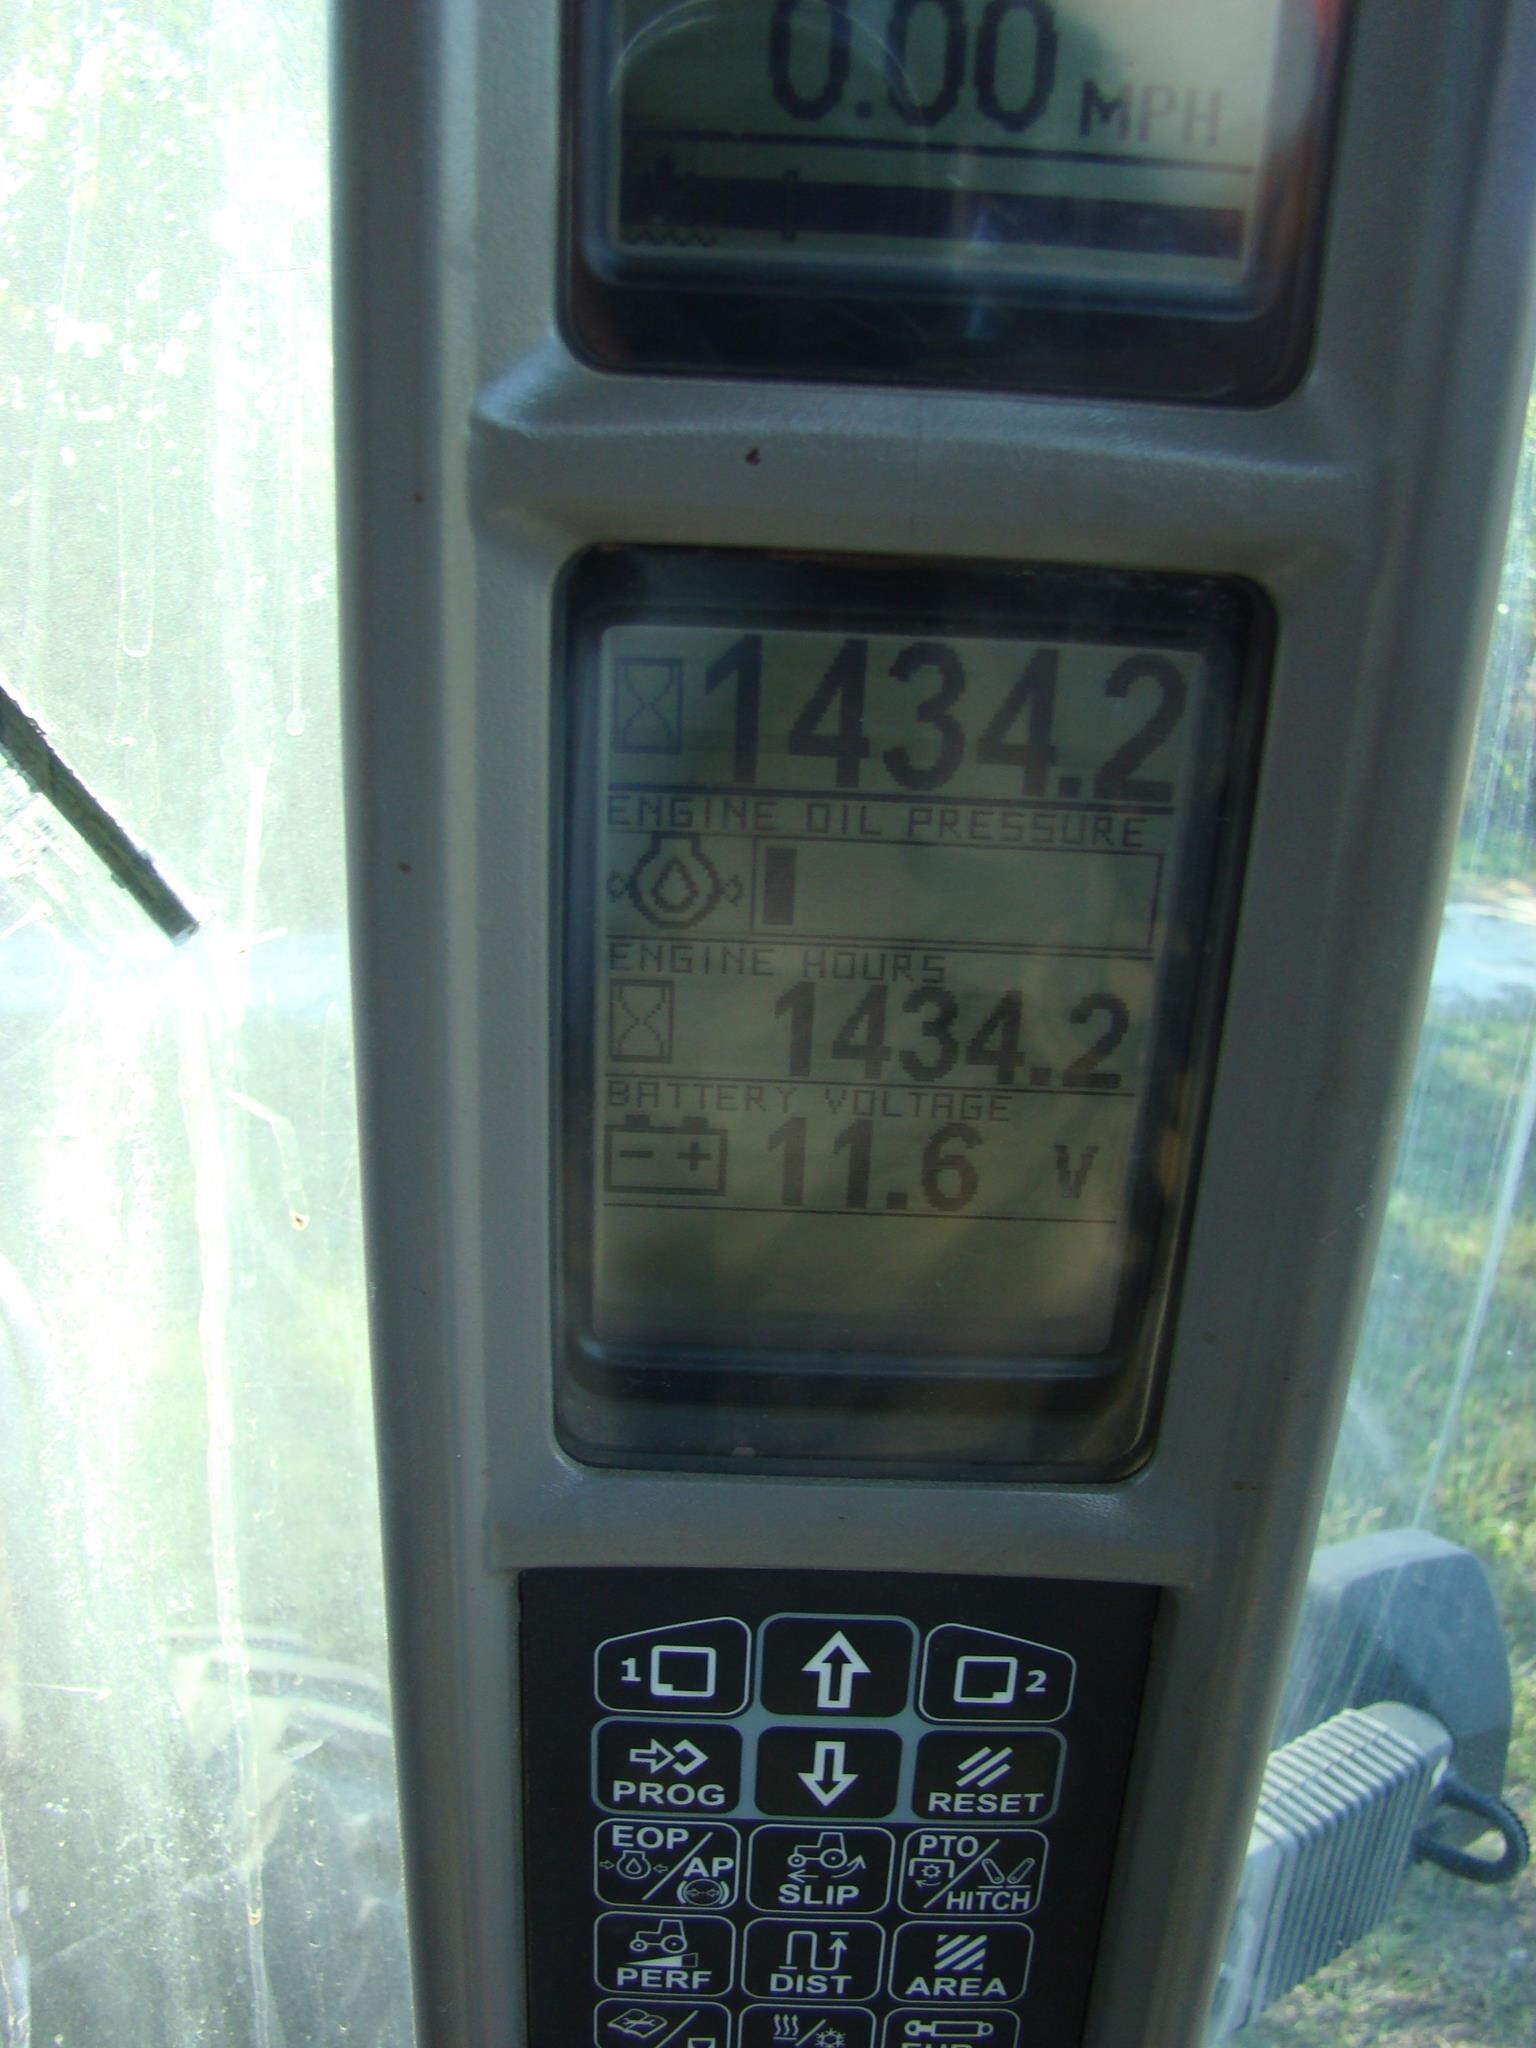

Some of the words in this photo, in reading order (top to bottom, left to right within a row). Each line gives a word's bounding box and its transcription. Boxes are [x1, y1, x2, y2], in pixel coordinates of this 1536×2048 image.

[768, 0, 1058, 133] 0.00
[1079, 79, 1221, 146] MPH
[704, 634, 1187, 801] 1434.2
[608, 794, 777, 833] ENGINE
[807, 802, 882, 836] OIL
[909, 807, 1148, 848] PRESSURE
[609, 942, 773, 976] ENGINE
[802, 950, 946, 983] HOURS
[773, 981, 1130, 1088] 1434.2
[608, 1081, 796, 1112] BATTERY
[825, 1087, 1013, 1121] VOLTAGE
[768, 1117, 984, 1211] 11.6
[1054, 1144, 1099, 1199] V
[620, 1657, 642, 1682] 1
[1024, 1669, 1047, 1693] 2
[612, 1780, 726, 1806] PROG
[927, 1791, 1044, 1814] RESET
[611, 1825, 689, 1850] EOP
[918, 1835, 979, 1858] PTO
[682, 1857, 734, 1879] AP
[778, 1884, 860, 1905] SLIP
[946, 1890, 1031, 1911] HITCH
[617, 1967, 712, 1989] PERF
[770, 1972, 852, 1994] DIST
[905, 1976, 1006, 1997] AREA
